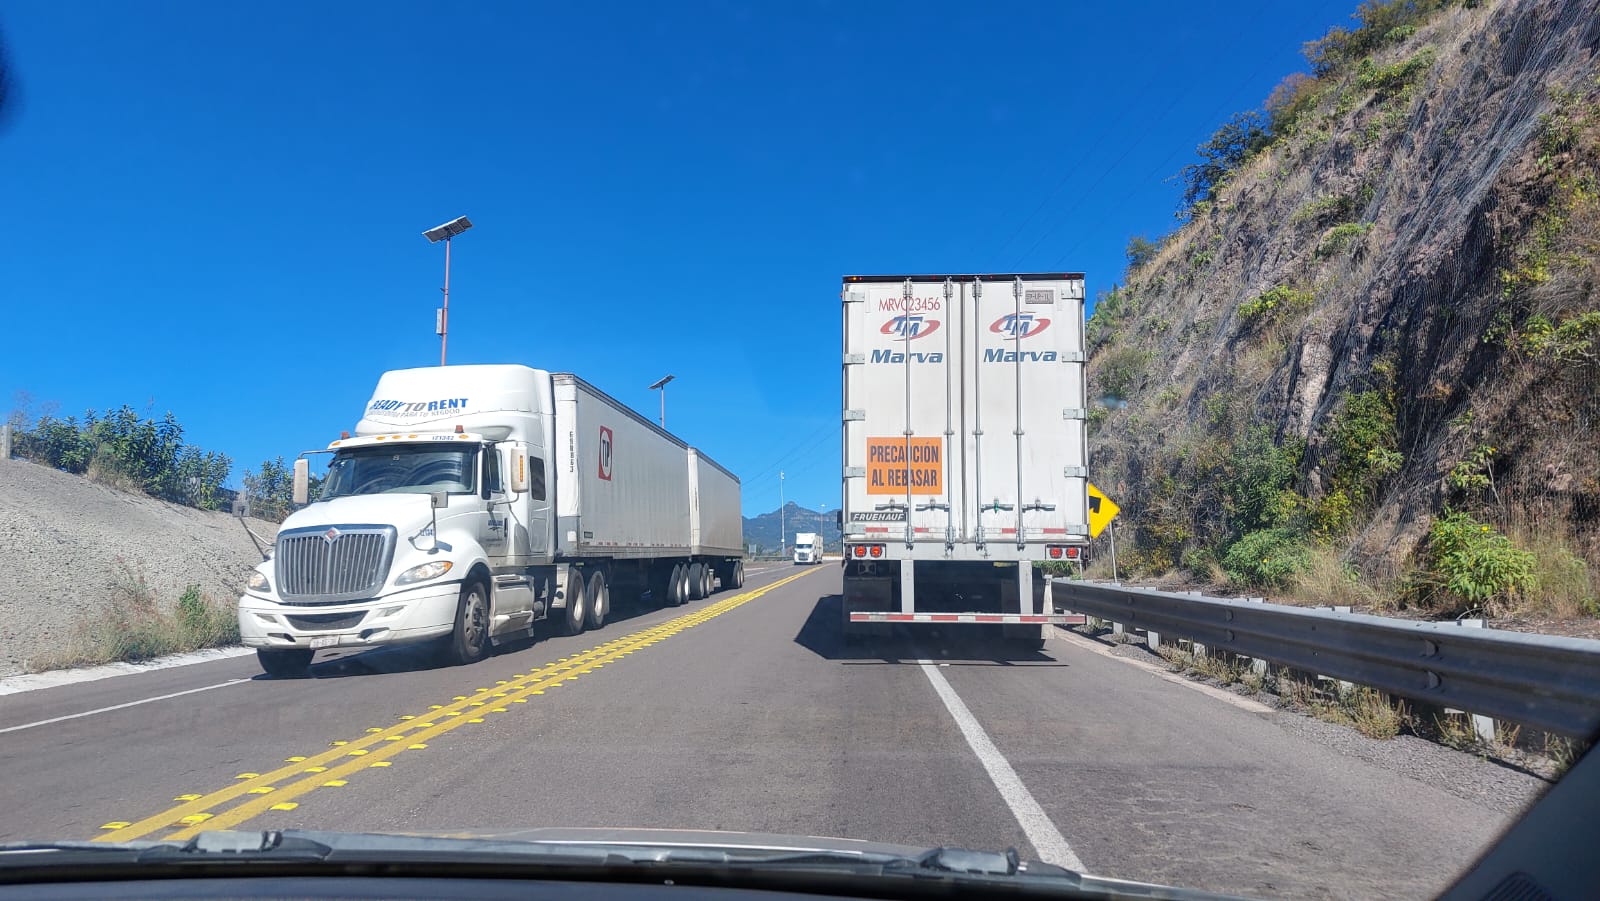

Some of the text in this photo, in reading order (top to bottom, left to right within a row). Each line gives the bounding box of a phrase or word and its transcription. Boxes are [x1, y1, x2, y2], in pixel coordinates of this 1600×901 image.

[871, 349, 943, 364] Marva
[983, 348, 1057, 363] Marva
[369, 398, 469, 412] READY TO RENT
[602, 439, 610, 468] TIP
[870, 441, 939, 463] PRECAUCIÓN
[872, 469, 937, 487] AL REBASAR
[853, 513, 905, 521] FRUEHAUF
